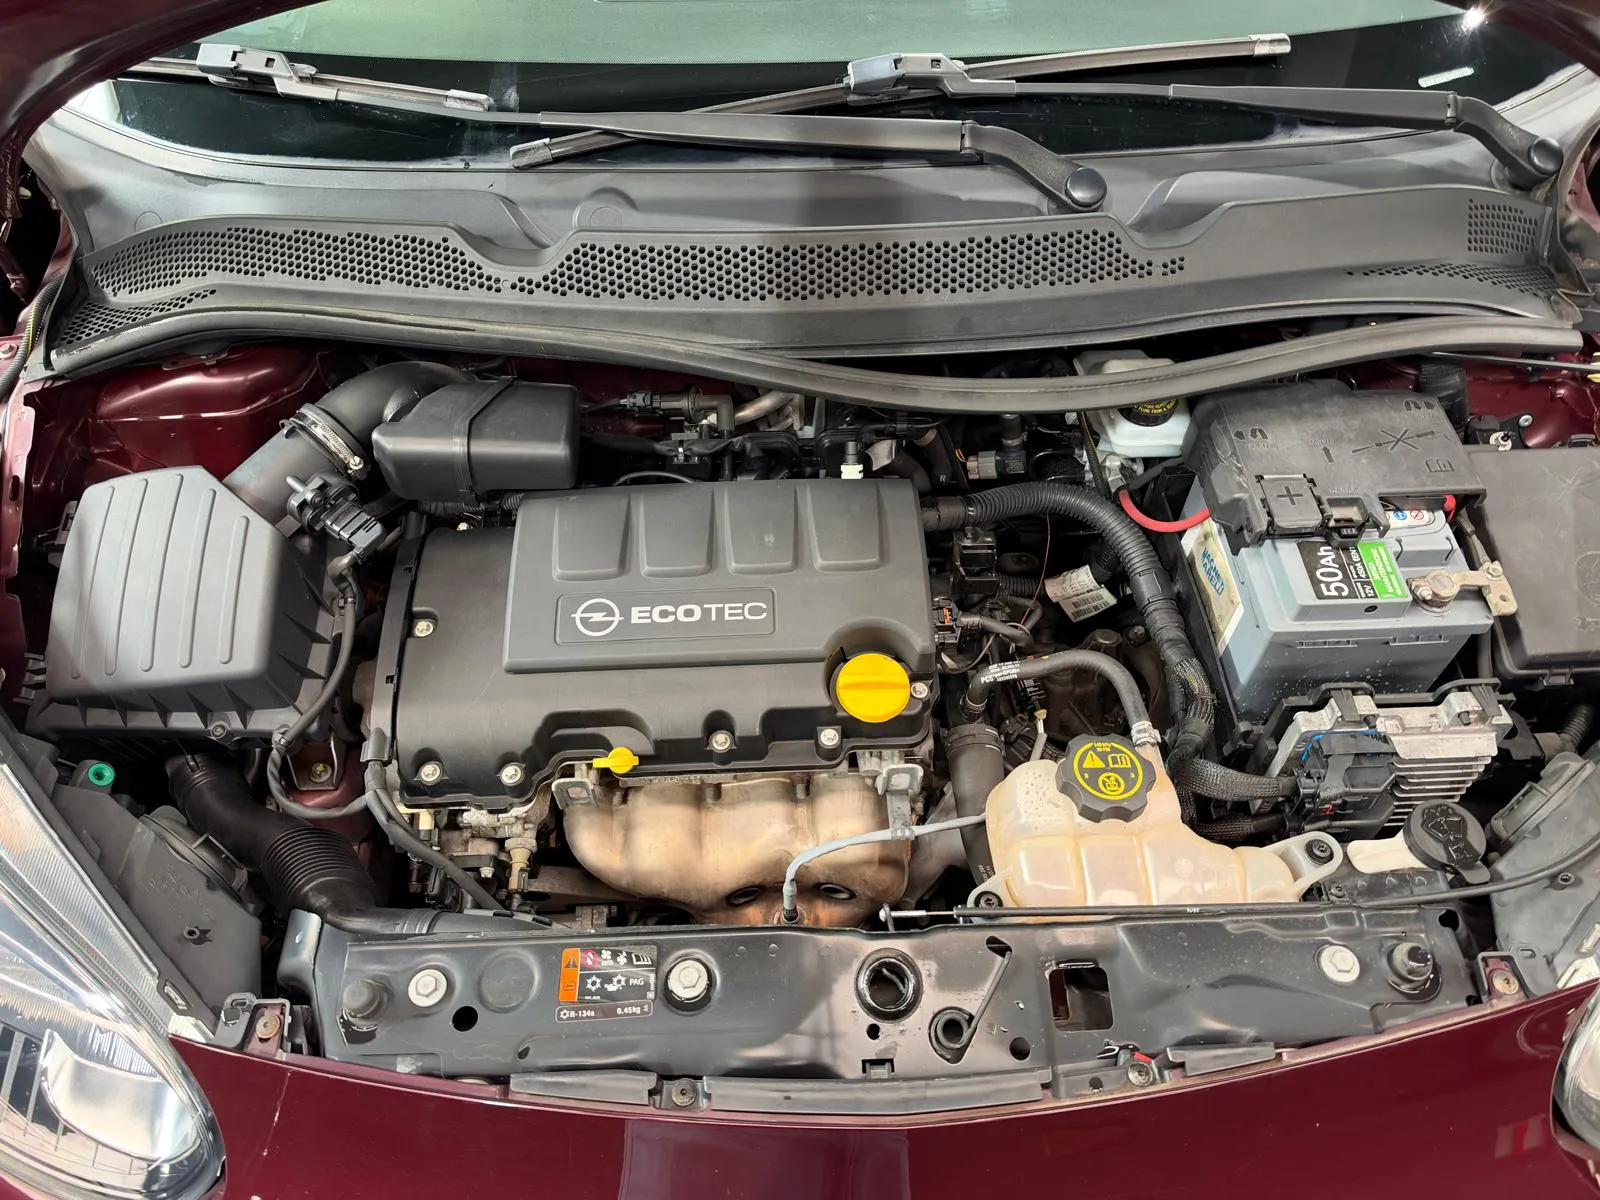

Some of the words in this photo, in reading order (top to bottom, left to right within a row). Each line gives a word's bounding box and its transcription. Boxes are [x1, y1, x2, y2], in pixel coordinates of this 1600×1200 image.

[1315, 545, 1349, 597] 50Ah
[1363, 584, 1375, 597] 12V
[630, 602, 768, 625] ECOTEC
[629, 978, 645, 986] PAG
[569, 1009, 595, 1018] R-134a
